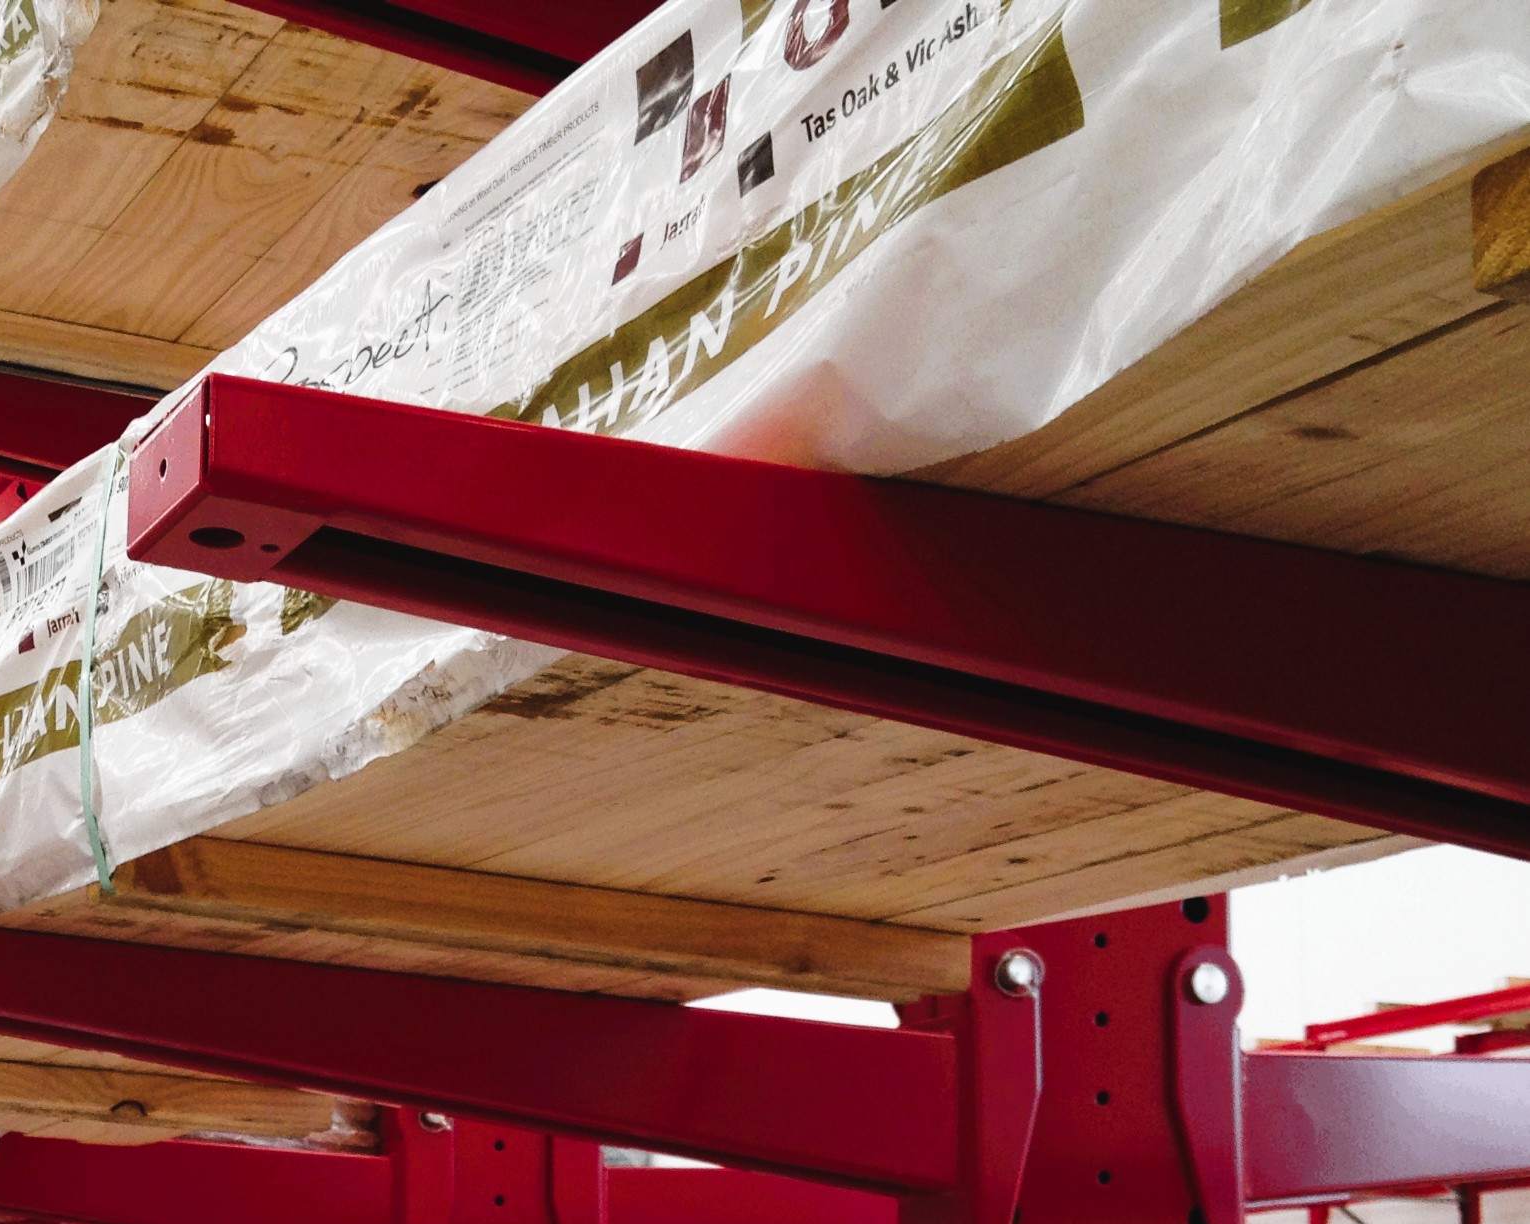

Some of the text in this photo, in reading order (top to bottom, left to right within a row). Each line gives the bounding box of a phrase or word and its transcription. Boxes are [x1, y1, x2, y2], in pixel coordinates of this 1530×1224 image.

[801, 1, 980, 143] Tas Oak & Vic Ash
[97, 618, 173, 709] PINE
